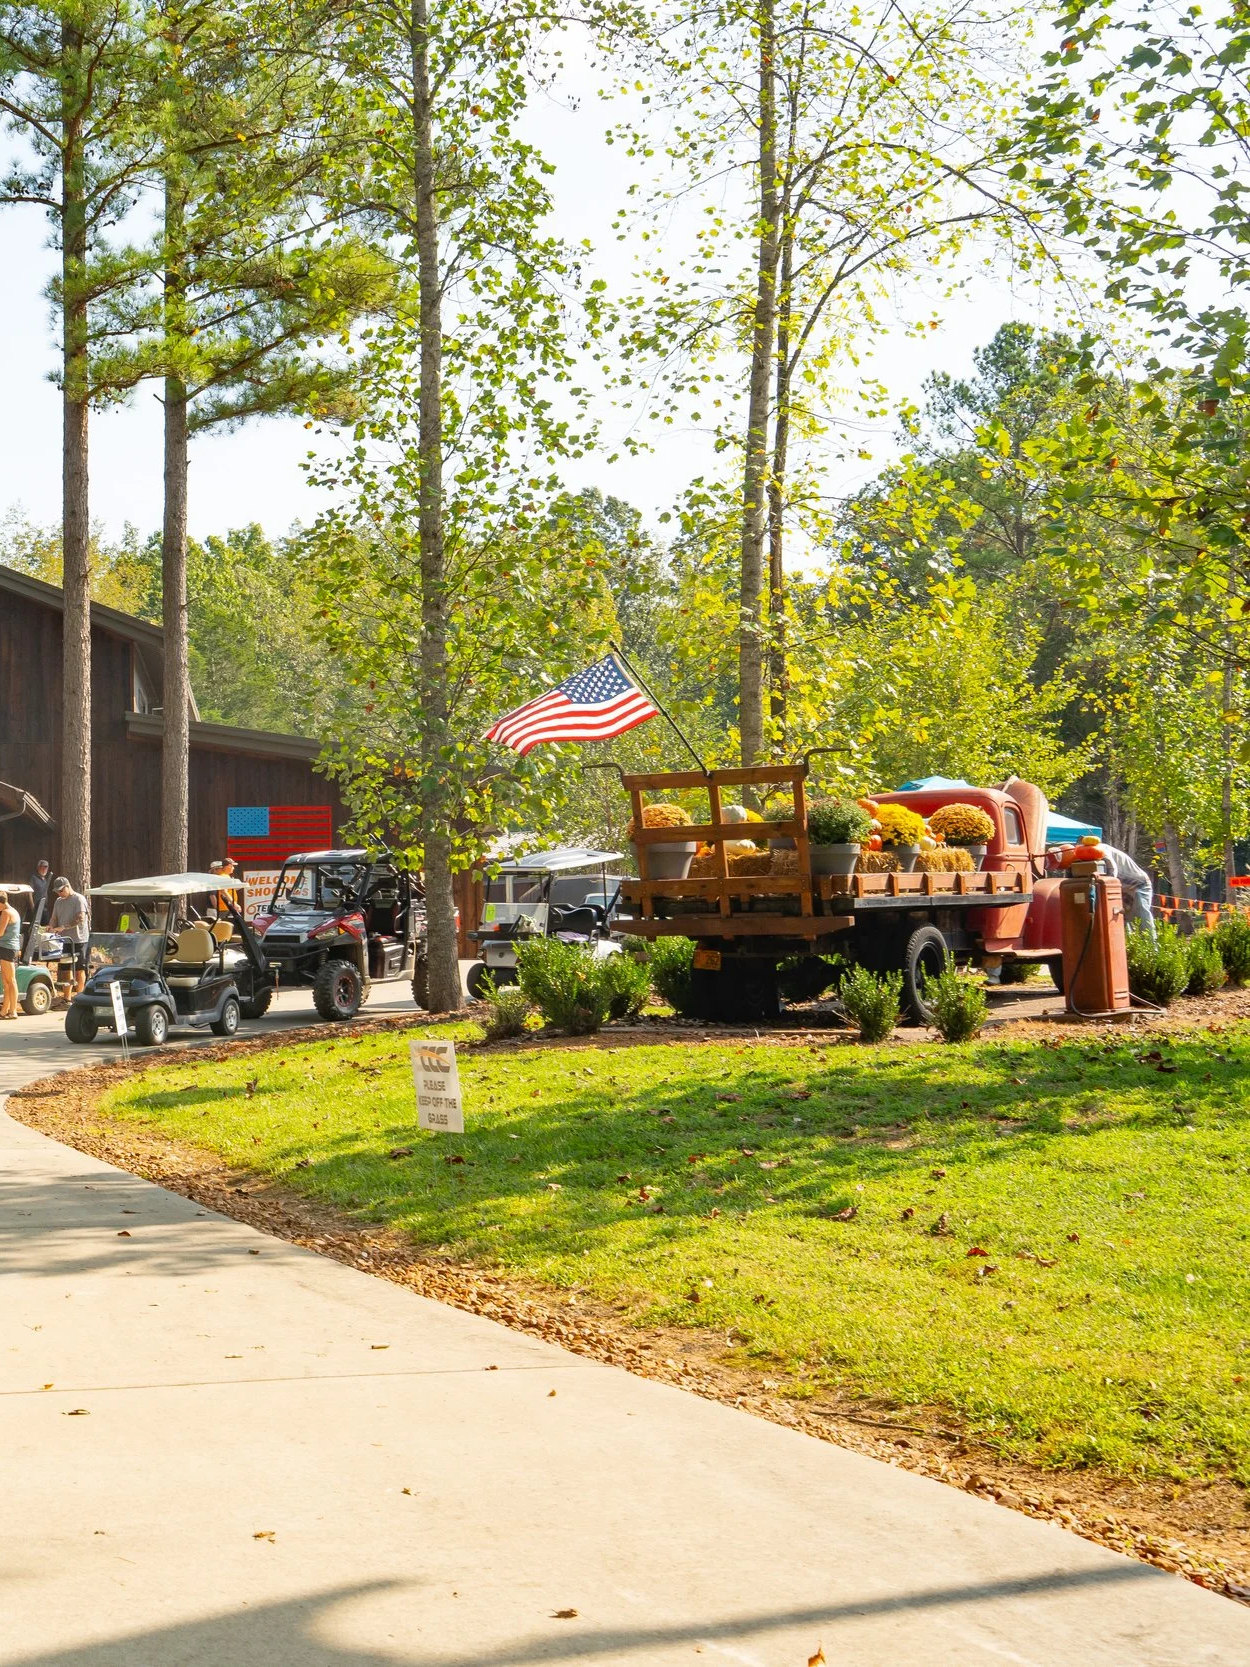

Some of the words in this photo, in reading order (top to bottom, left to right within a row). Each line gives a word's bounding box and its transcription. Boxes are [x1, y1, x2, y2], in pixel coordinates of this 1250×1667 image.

[423, 1080, 446, 1091] PLEASE
[432, 1096, 443, 1107] OFF
[444, 1098, 457, 1109] THE
[428, 1113, 448, 1125] GRASS
